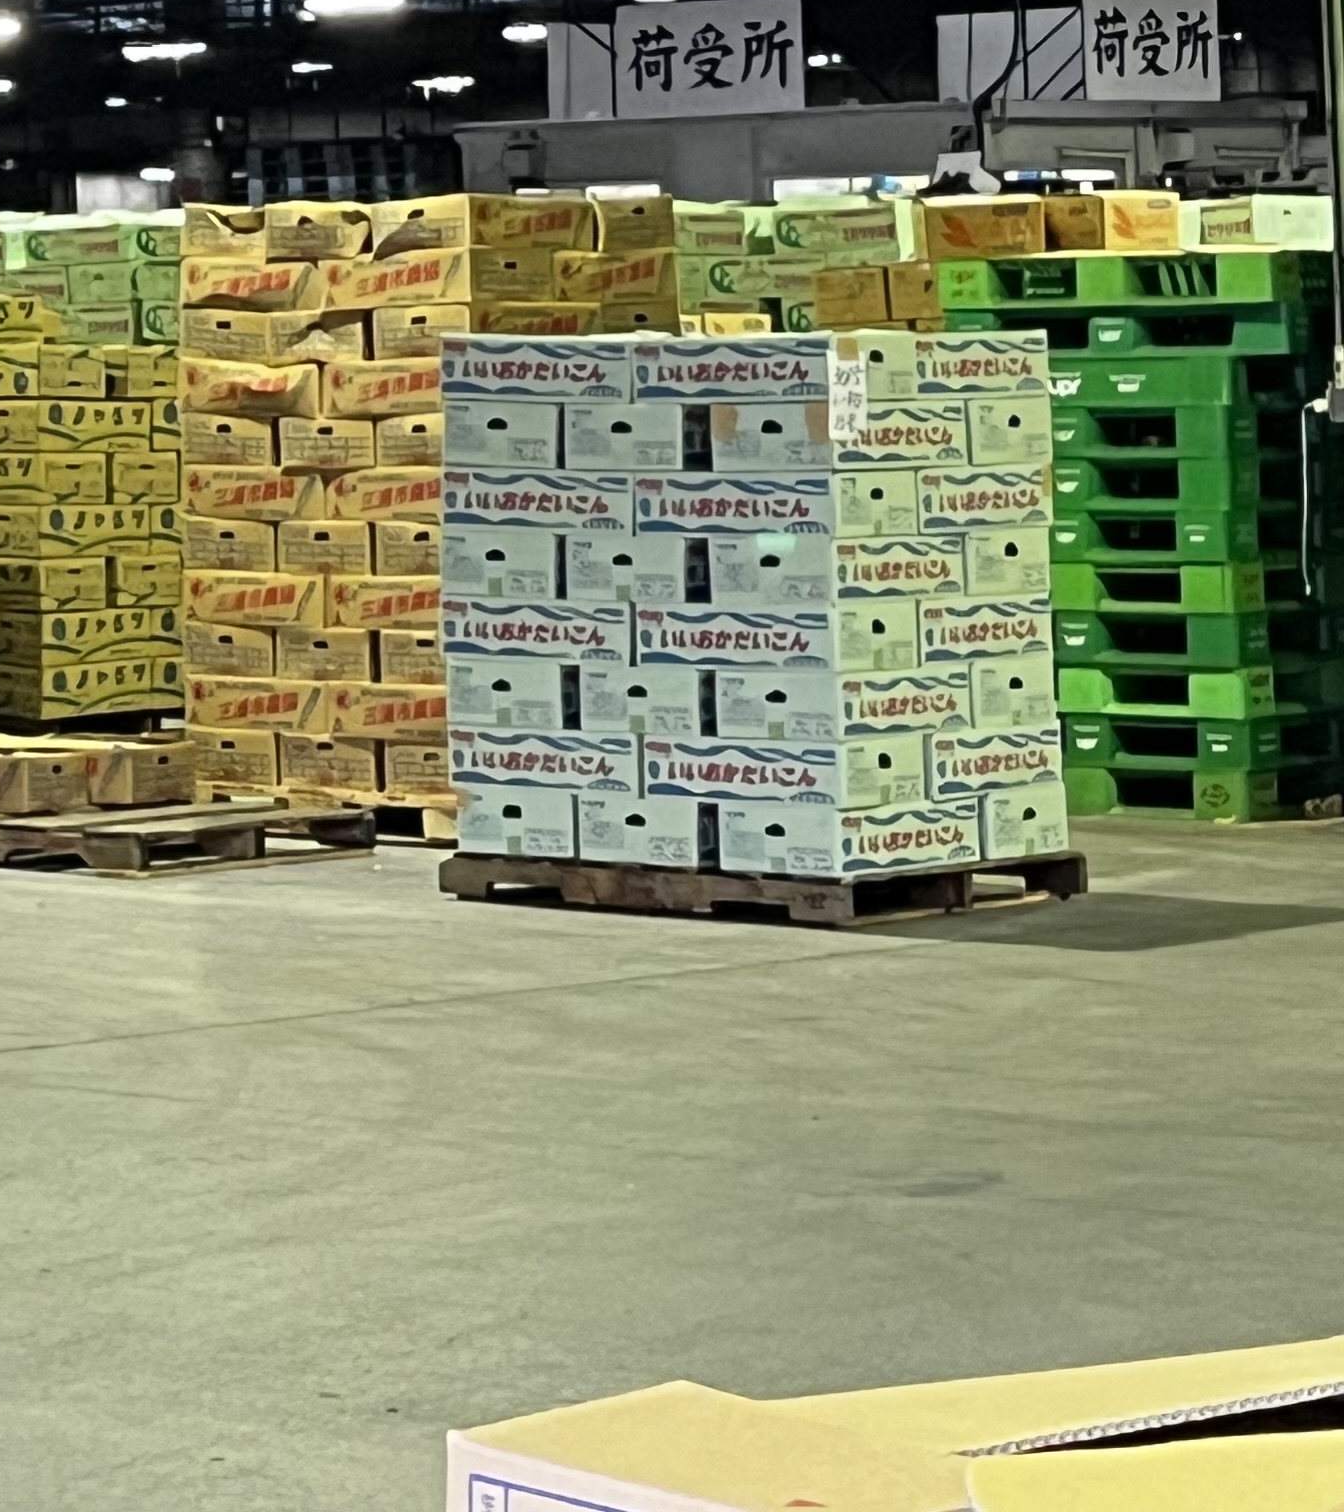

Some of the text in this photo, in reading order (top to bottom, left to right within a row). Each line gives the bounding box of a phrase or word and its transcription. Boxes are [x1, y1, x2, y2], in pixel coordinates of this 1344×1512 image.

[628, 20, 795, 92] 荷受所
[1092, 7, 1214, 80] 荷受所
[462, 360, 606, 382] いいおかだいこん
[658, 361, 809, 382] いいおかだいこん
[464, 491, 609, 513] いいおかだいこん
[659, 497, 810, 519] いいおかだいこん
[463, 621, 606, 646] いいおかだいこん
[661, 628, 810, 653] いいおかだいこん
[470, 751, 614, 776] いいおかだいこん
[668, 761, 817, 787] いいおかだいこん
